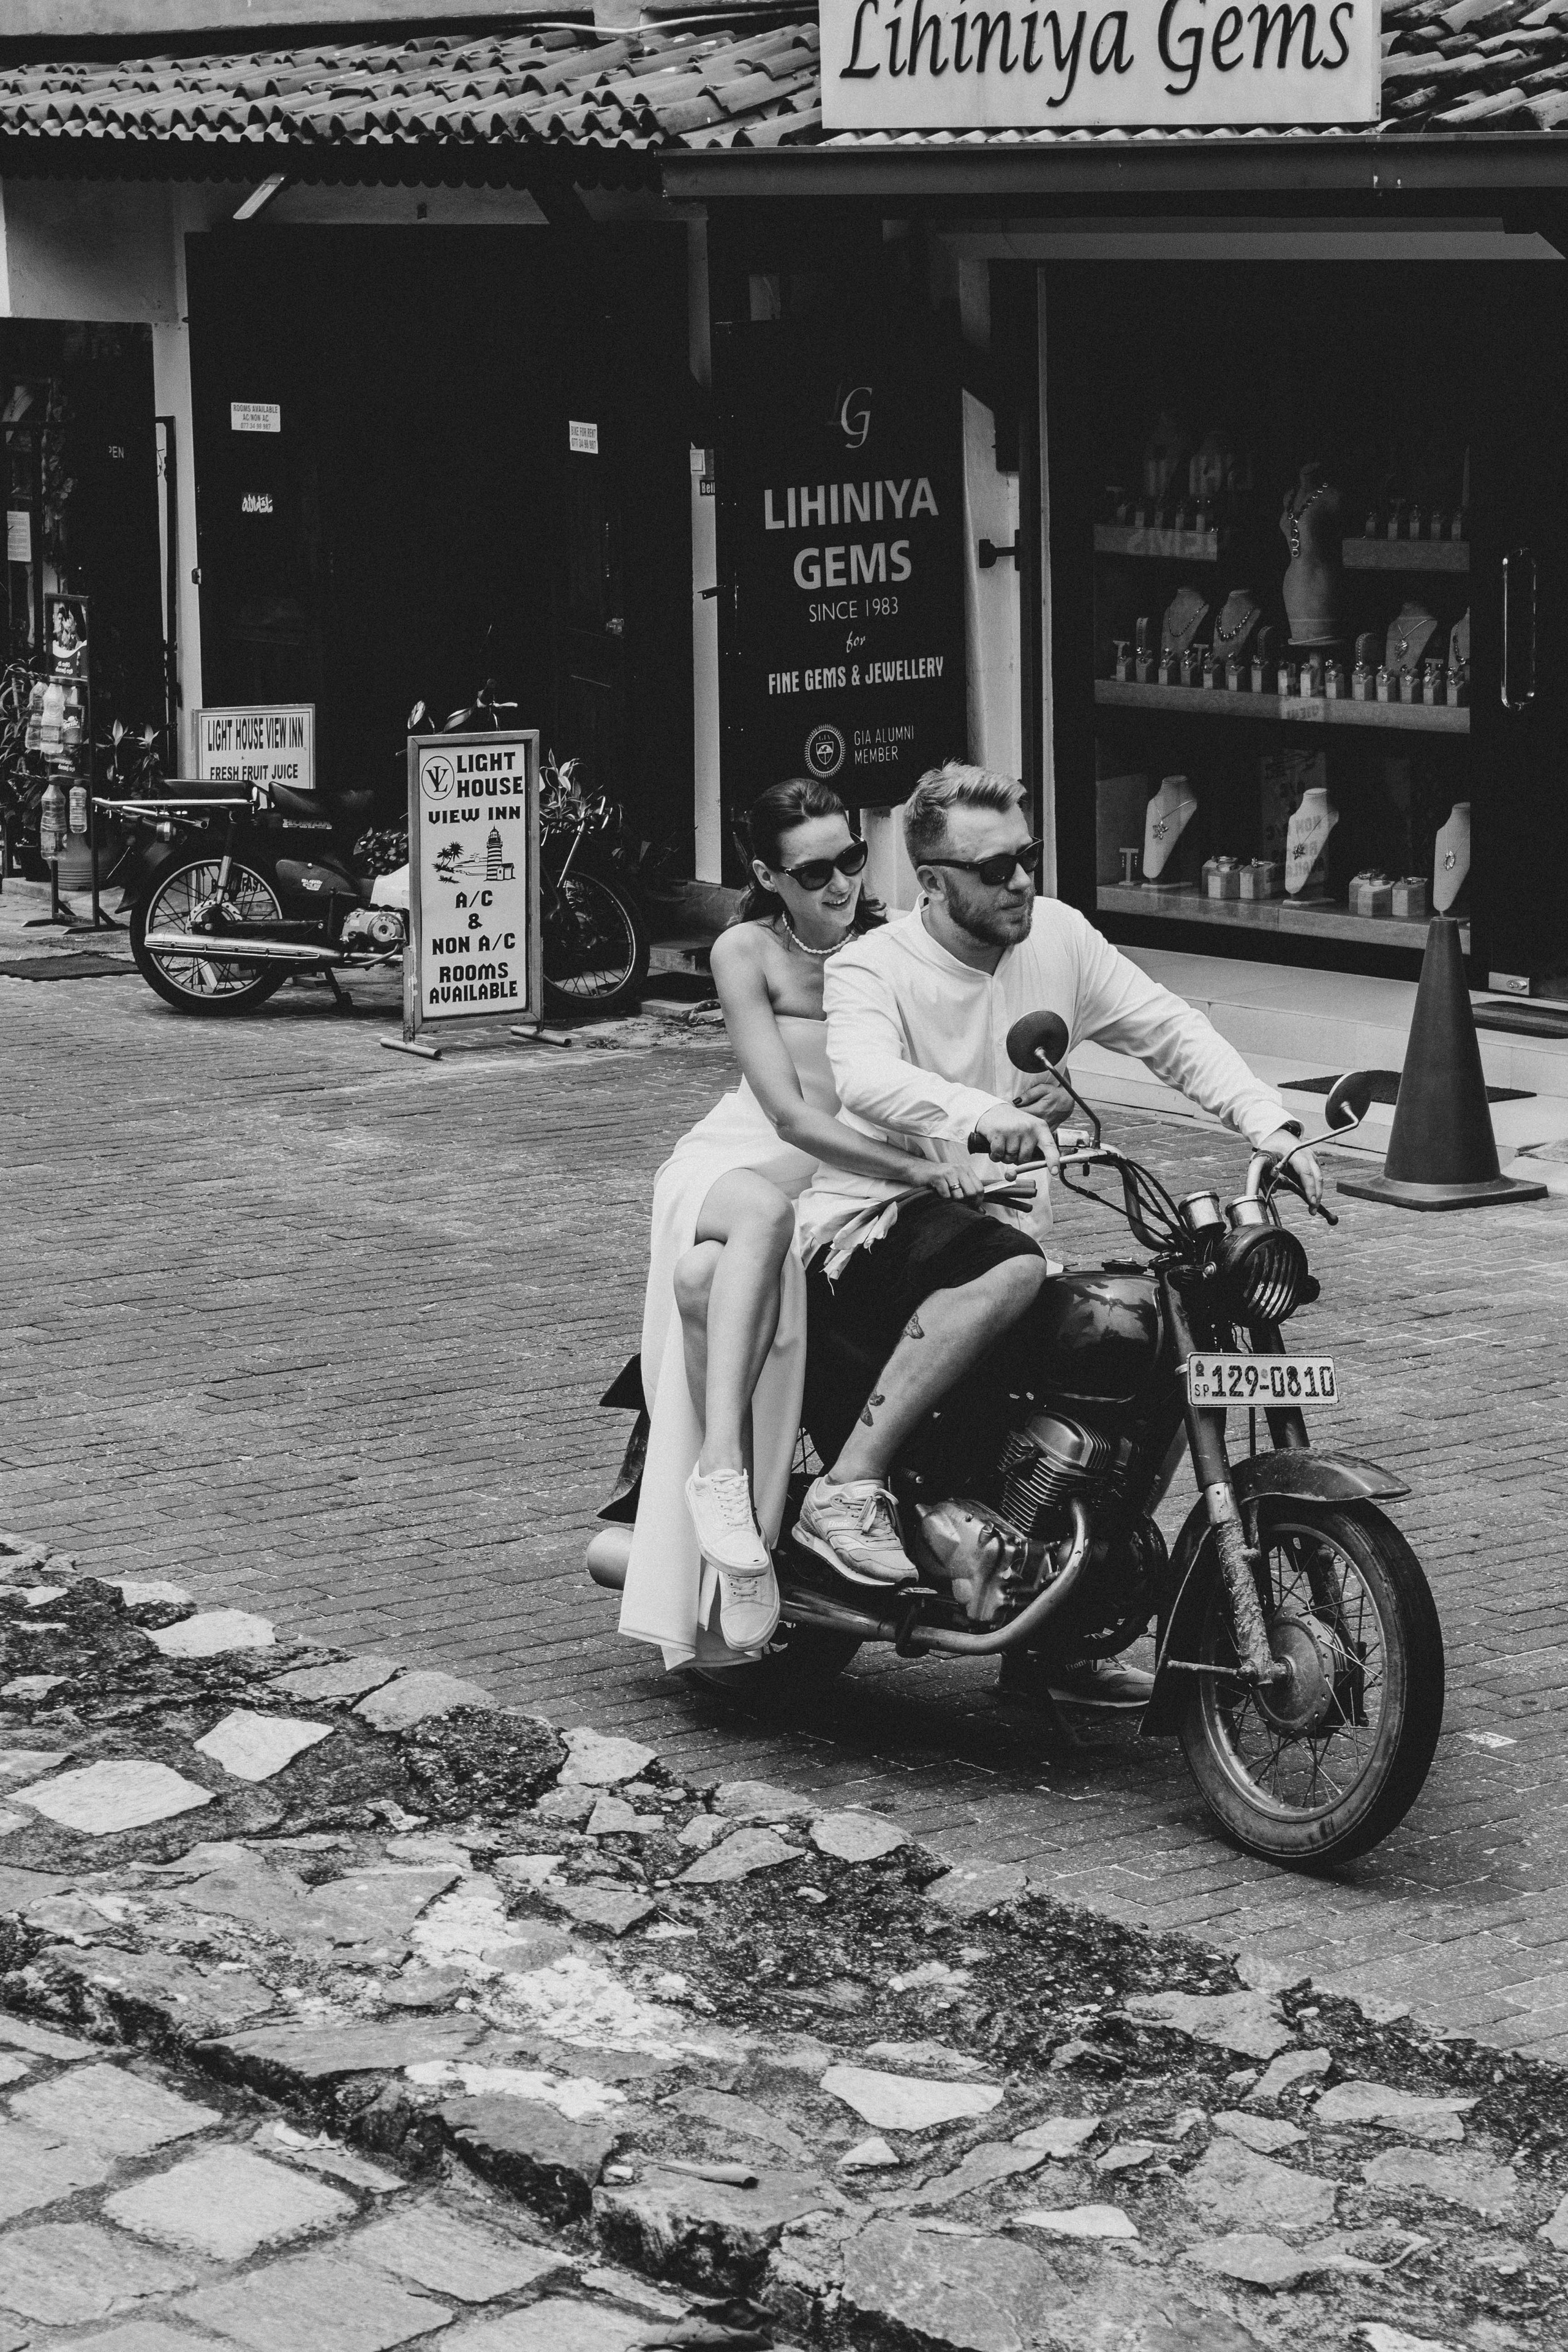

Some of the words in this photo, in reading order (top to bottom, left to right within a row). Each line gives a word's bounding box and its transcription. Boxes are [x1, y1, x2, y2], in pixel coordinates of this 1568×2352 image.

[839, 0, 1134, 107] Lihiniya
[1158, 0, 1354, 96] Gems
[701, 482, 715, 494] Bell
[764, 477, 939, 530] LIHINIYA
[793, 540, 912, 590] GEMS
[809, 600, 858, 622] SINCE
[866, 597, 899, 617] 1983
[846, 631, 866, 653] for
[768, 671, 800, 695] FINE
[804, 666, 846, 691] GEMS
[851, 665, 861, 685] &
[865, 656, 944, 684] JEWELLERY
[208, 719, 232, 751] LIGHT
[236, 718, 263, 750] HOUSE
[266, 717, 287, 748] VIEW
[289, 717, 303, 748] INN
[854, 729, 872, 745] GIA
[875, 725, 914, 744] ALUMNI
[456, 752, 516, 774] LIGHT
[854, 745, 899, 765] MEMBER
[210, 766, 239, 780] FRESH
[242, 765, 268, 780] FRUIT
[271, 764, 298, 779] JUICE
[456, 776, 524, 798] HOUSE
[428, 808, 480, 824] VIEW
[488, 806, 521, 821] INN
[455, 890, 493, 908] A/C
[467, 913, 483, 929] &
[432, 936, 470, 956] NON
[478, 932, 516, 952] A/C
[439, 962, 509, 983] ROOMS
[429, 980, 518, 1004] AVAILABLE
[1194, 1384, 1209, 1397] SP
[1212, 1365, 1335, 1397] 129-0810
